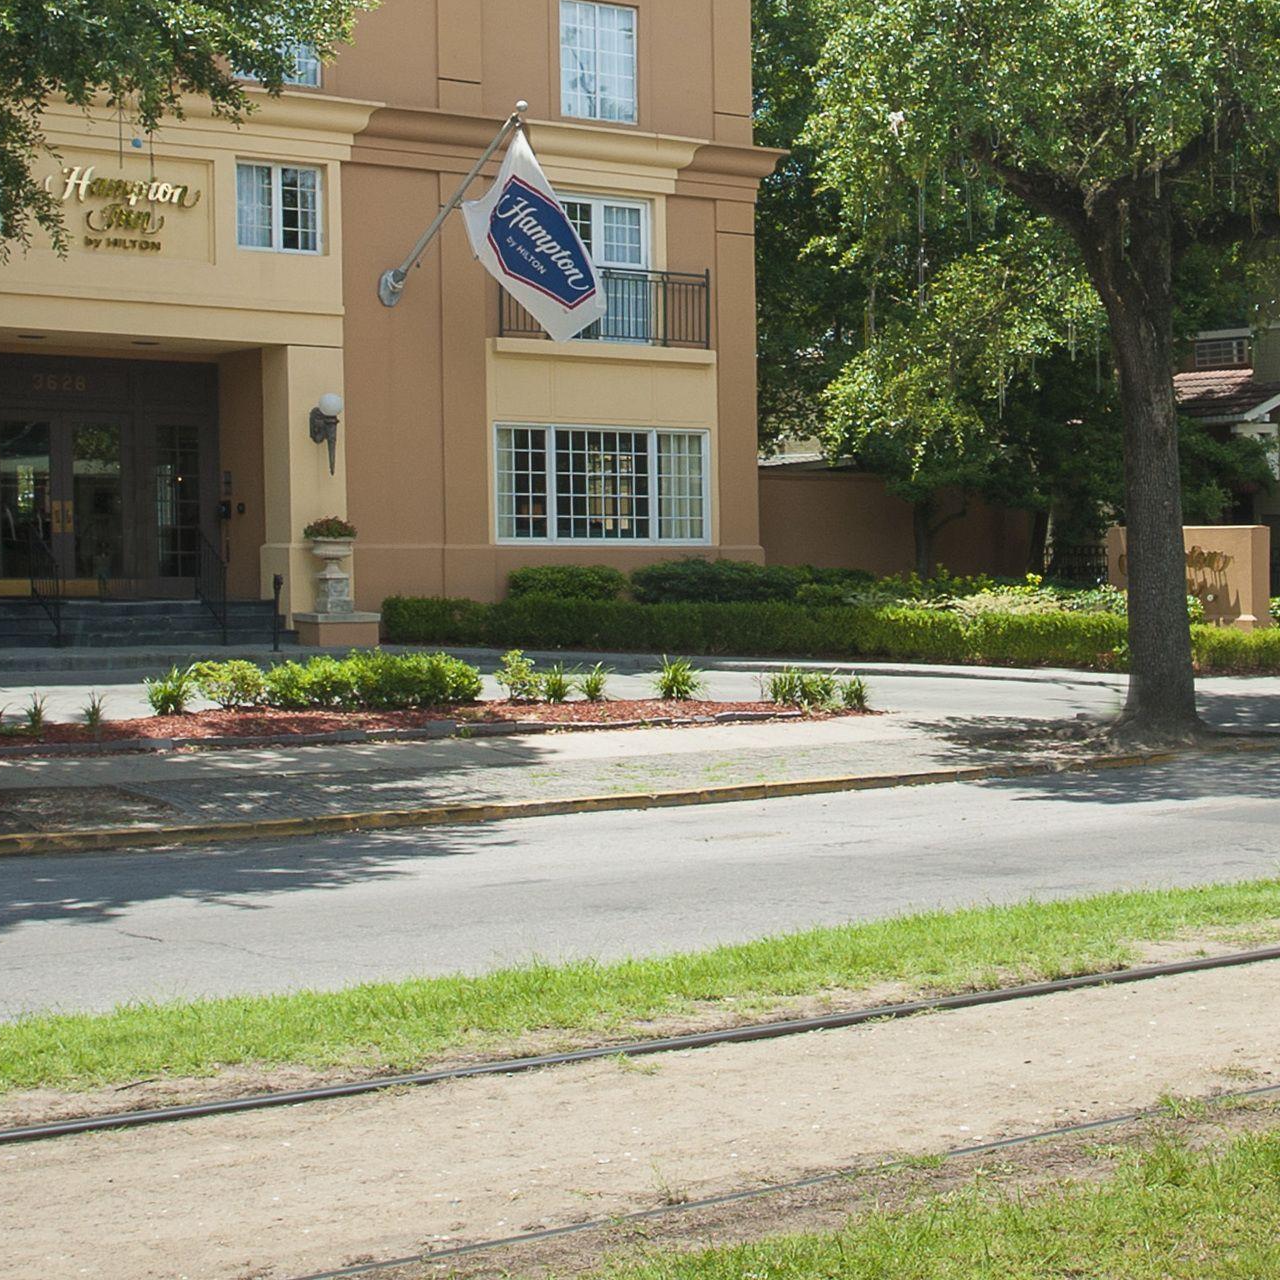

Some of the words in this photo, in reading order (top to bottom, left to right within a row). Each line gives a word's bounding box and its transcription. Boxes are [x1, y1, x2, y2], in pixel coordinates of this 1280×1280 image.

[45, 166, 201, 208] Hampton
[84, 235, 103, 249] by
[105, 237, 162, 251] HILTON
[496, 194, 589, 290] Hampton
[506, 236, 517, 247] by
[516, 244, 547, 274] HILTON
